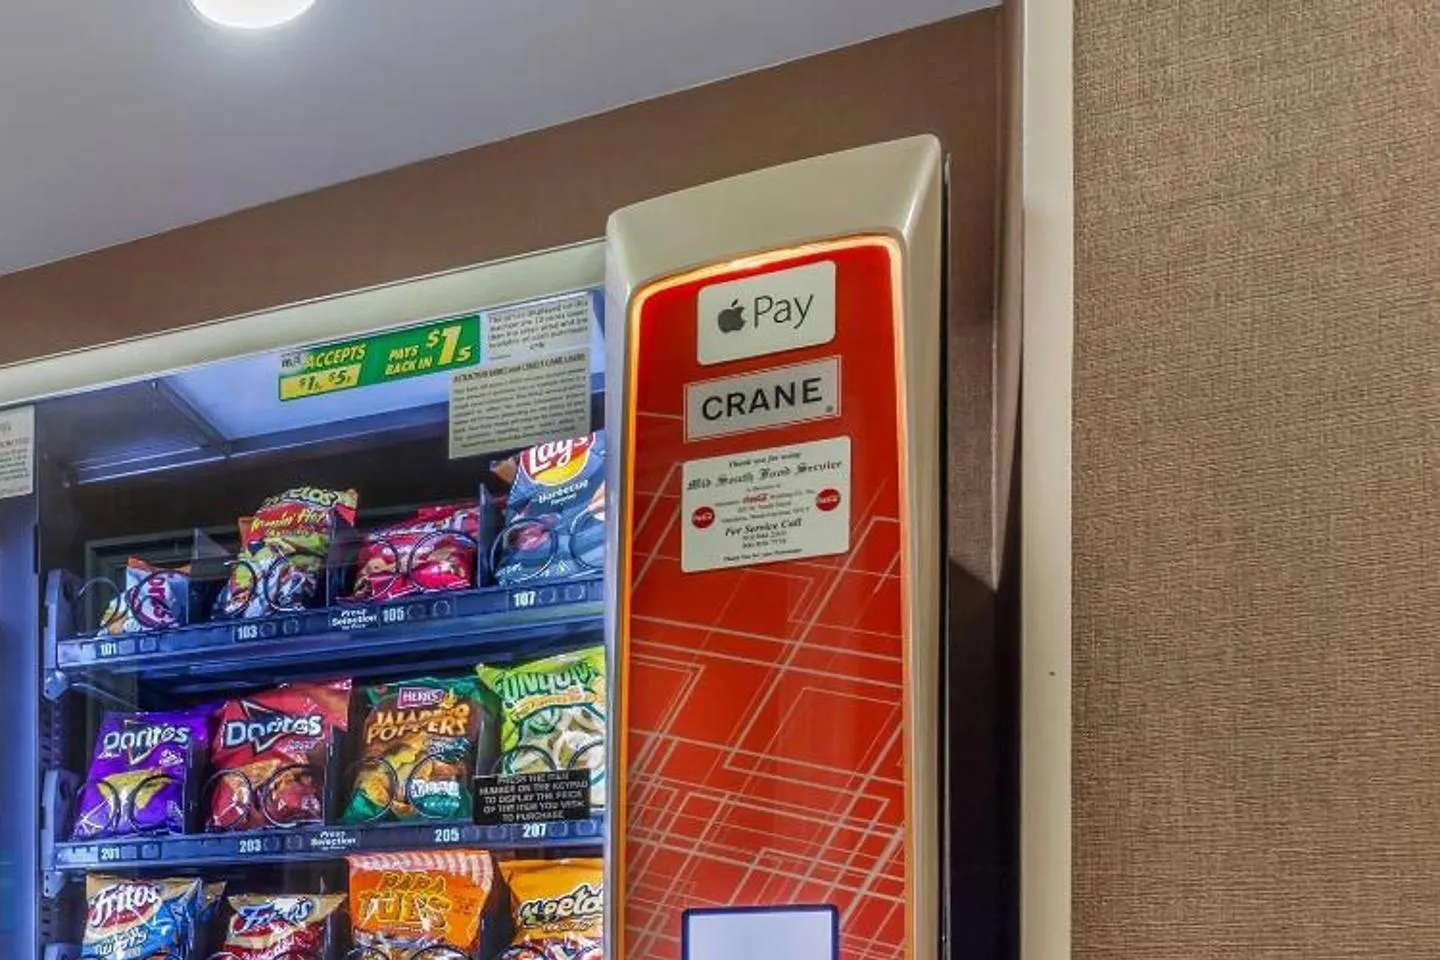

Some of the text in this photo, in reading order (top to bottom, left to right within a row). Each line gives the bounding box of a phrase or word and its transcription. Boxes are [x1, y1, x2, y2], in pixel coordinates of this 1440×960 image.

[753, 294, 814, 329] Pay
[306, 344, 367, 368] ACCEPTS
[389, 345, 420, 361] PAYS
[385, 357, 433, 375] BACK IN
[702, 377, 822, 421] CRANE
[514, 591, 536, 607] 107
[382, 606, 405, 623] 105
[237, 626, 258, 640] 103
[104, 724, 191, 751] Doritos
[226, 715, 323, 747] Doritos
[434, 828, 460, 842] 205
[523, 823, 546, 838] 207
[239, 840, 260, 853] 203
[90, 883, 162, 928] Fritos
